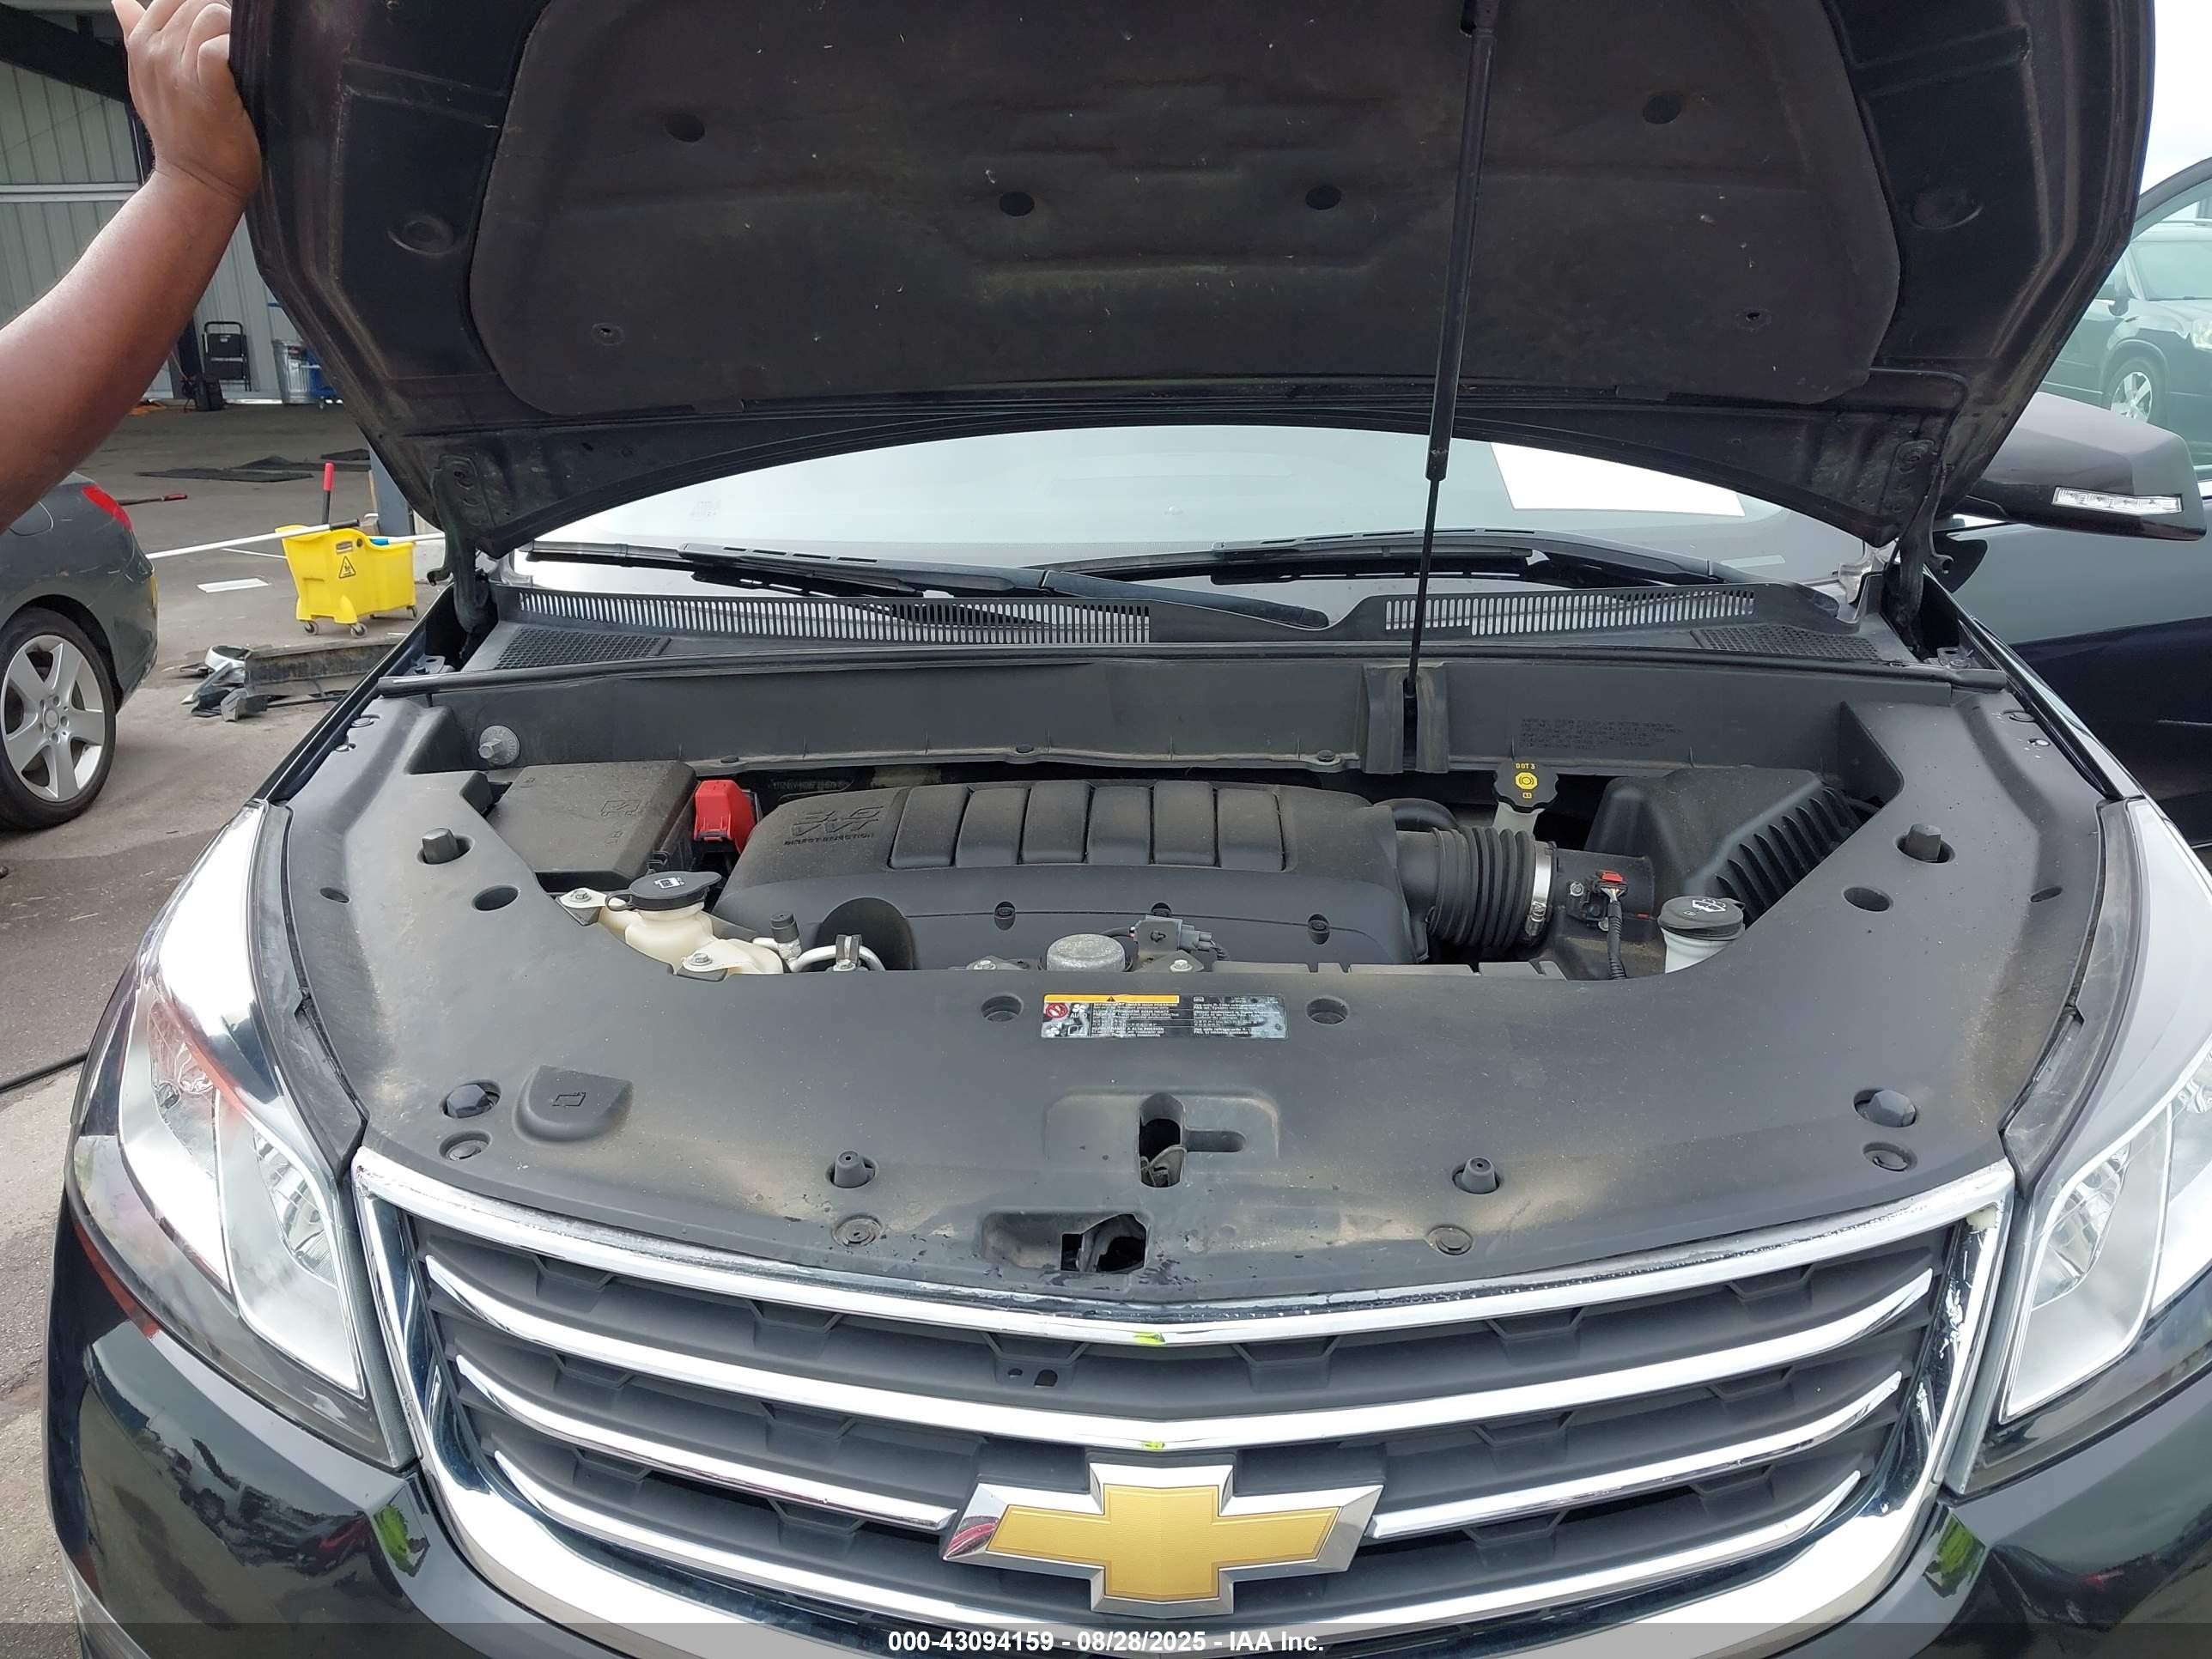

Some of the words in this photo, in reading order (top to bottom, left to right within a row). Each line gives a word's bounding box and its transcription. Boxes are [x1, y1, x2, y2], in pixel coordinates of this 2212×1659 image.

[802, 805, 884, 822] 3.6
[784, 836, 820, 846] DIRECT
[823, 832, 873, 842] INJECTION
